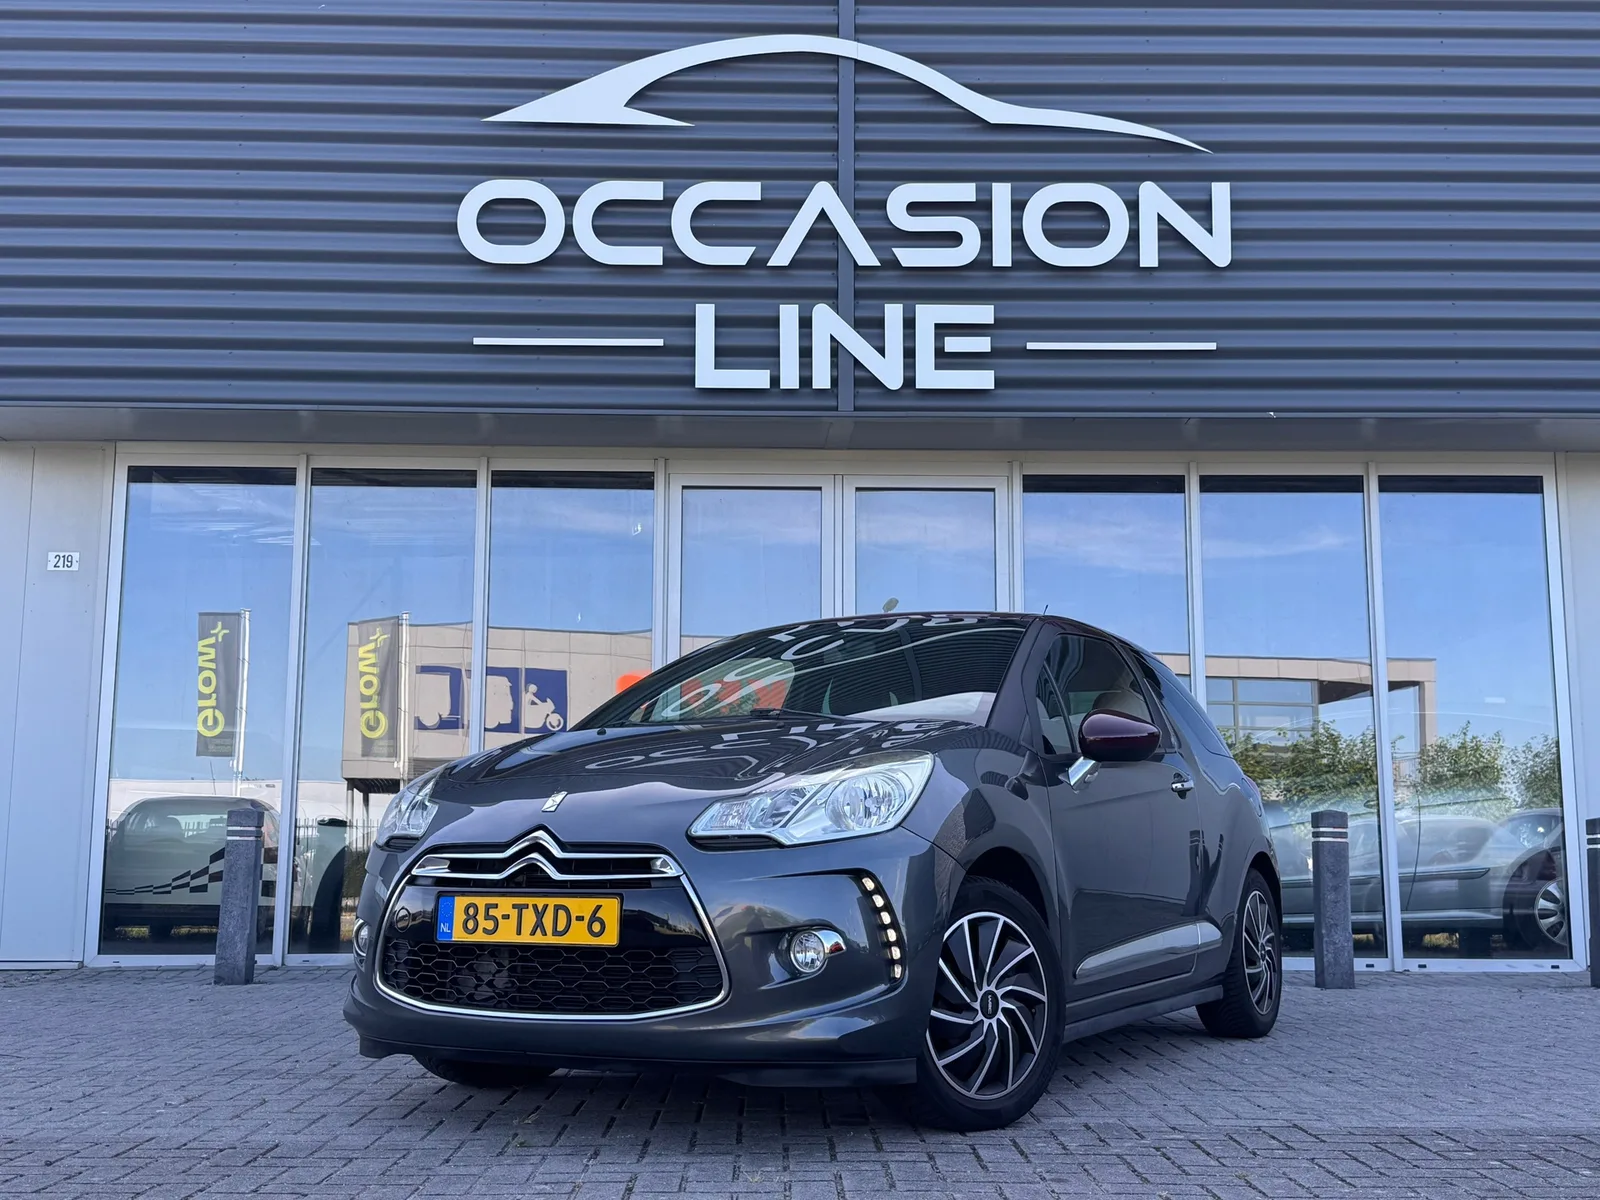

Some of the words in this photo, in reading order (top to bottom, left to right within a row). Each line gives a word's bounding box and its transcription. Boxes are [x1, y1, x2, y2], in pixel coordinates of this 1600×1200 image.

[457, 179, 1233, 268] OCCASION
[695, 303, 996, 391] LINE
[53, 554, 73, 568] 219
[440, 923, 451, 933] NL
[462, 902, 606, 938] 85-TXD-6
